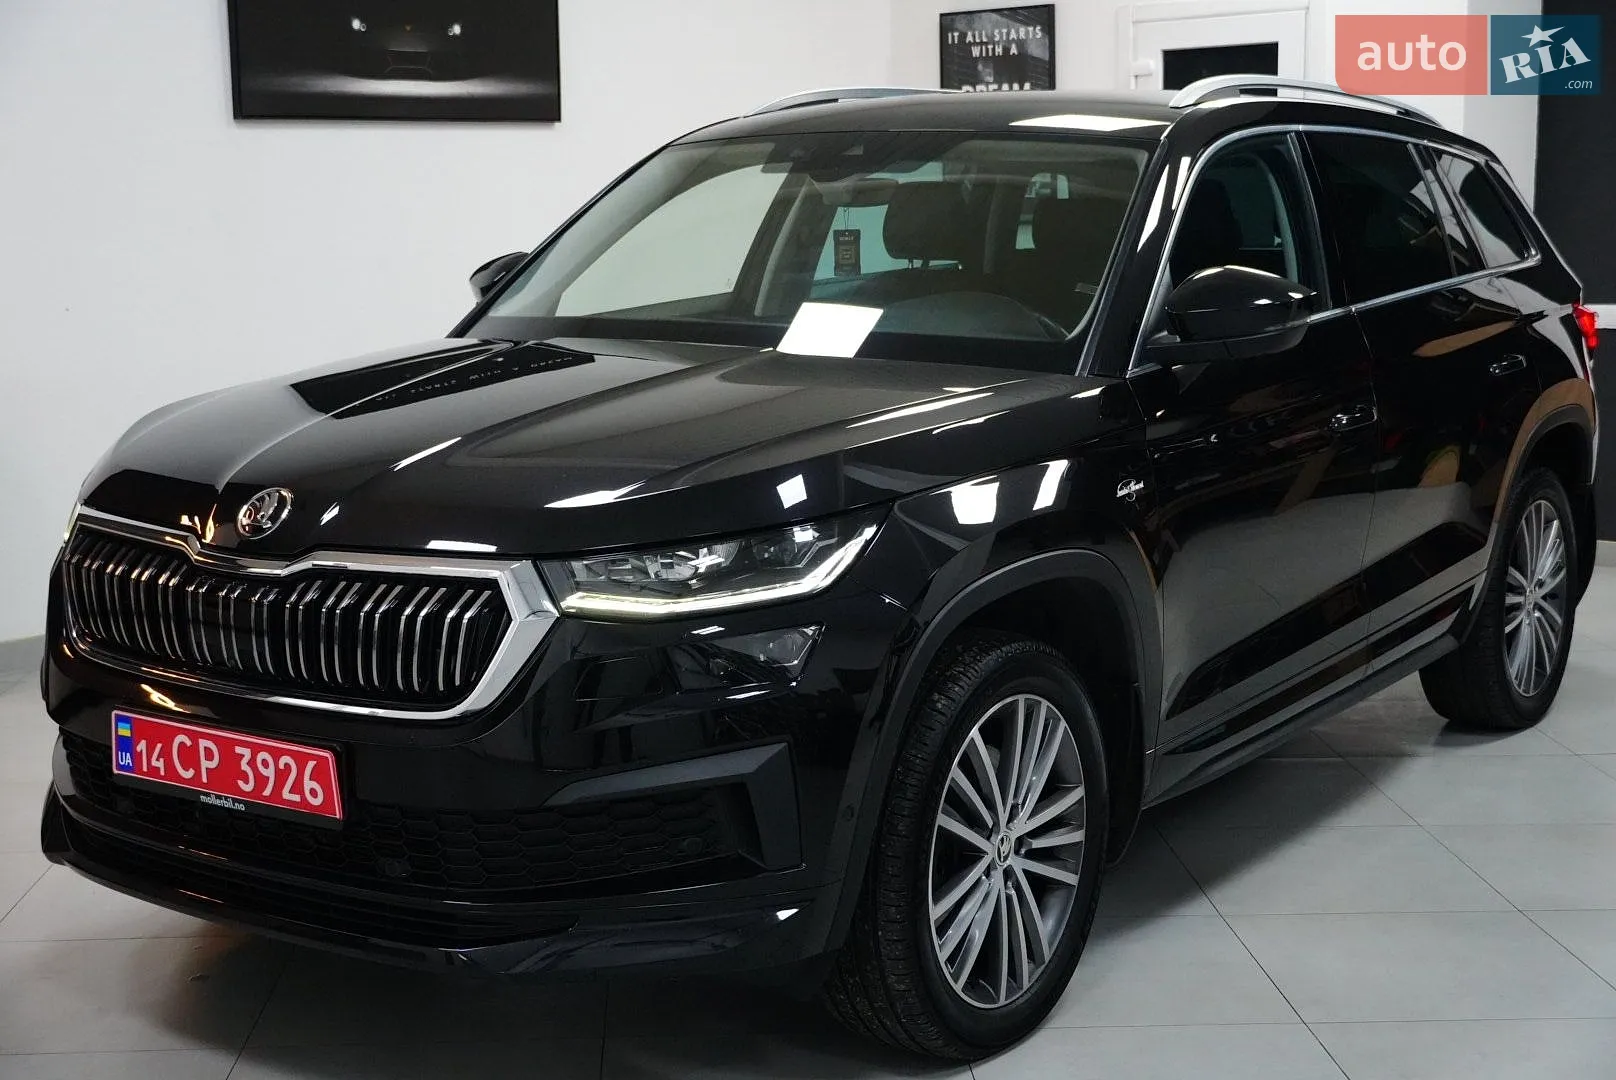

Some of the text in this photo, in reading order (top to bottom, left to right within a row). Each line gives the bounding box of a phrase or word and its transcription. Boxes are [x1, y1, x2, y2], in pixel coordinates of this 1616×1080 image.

[948, 26, 1042, 44] IT ALL STARTS
[971, 43, 1018, 57] WITH A
[118, 752, 132, 767] UA
[234, 745, 324, 806] 3926
